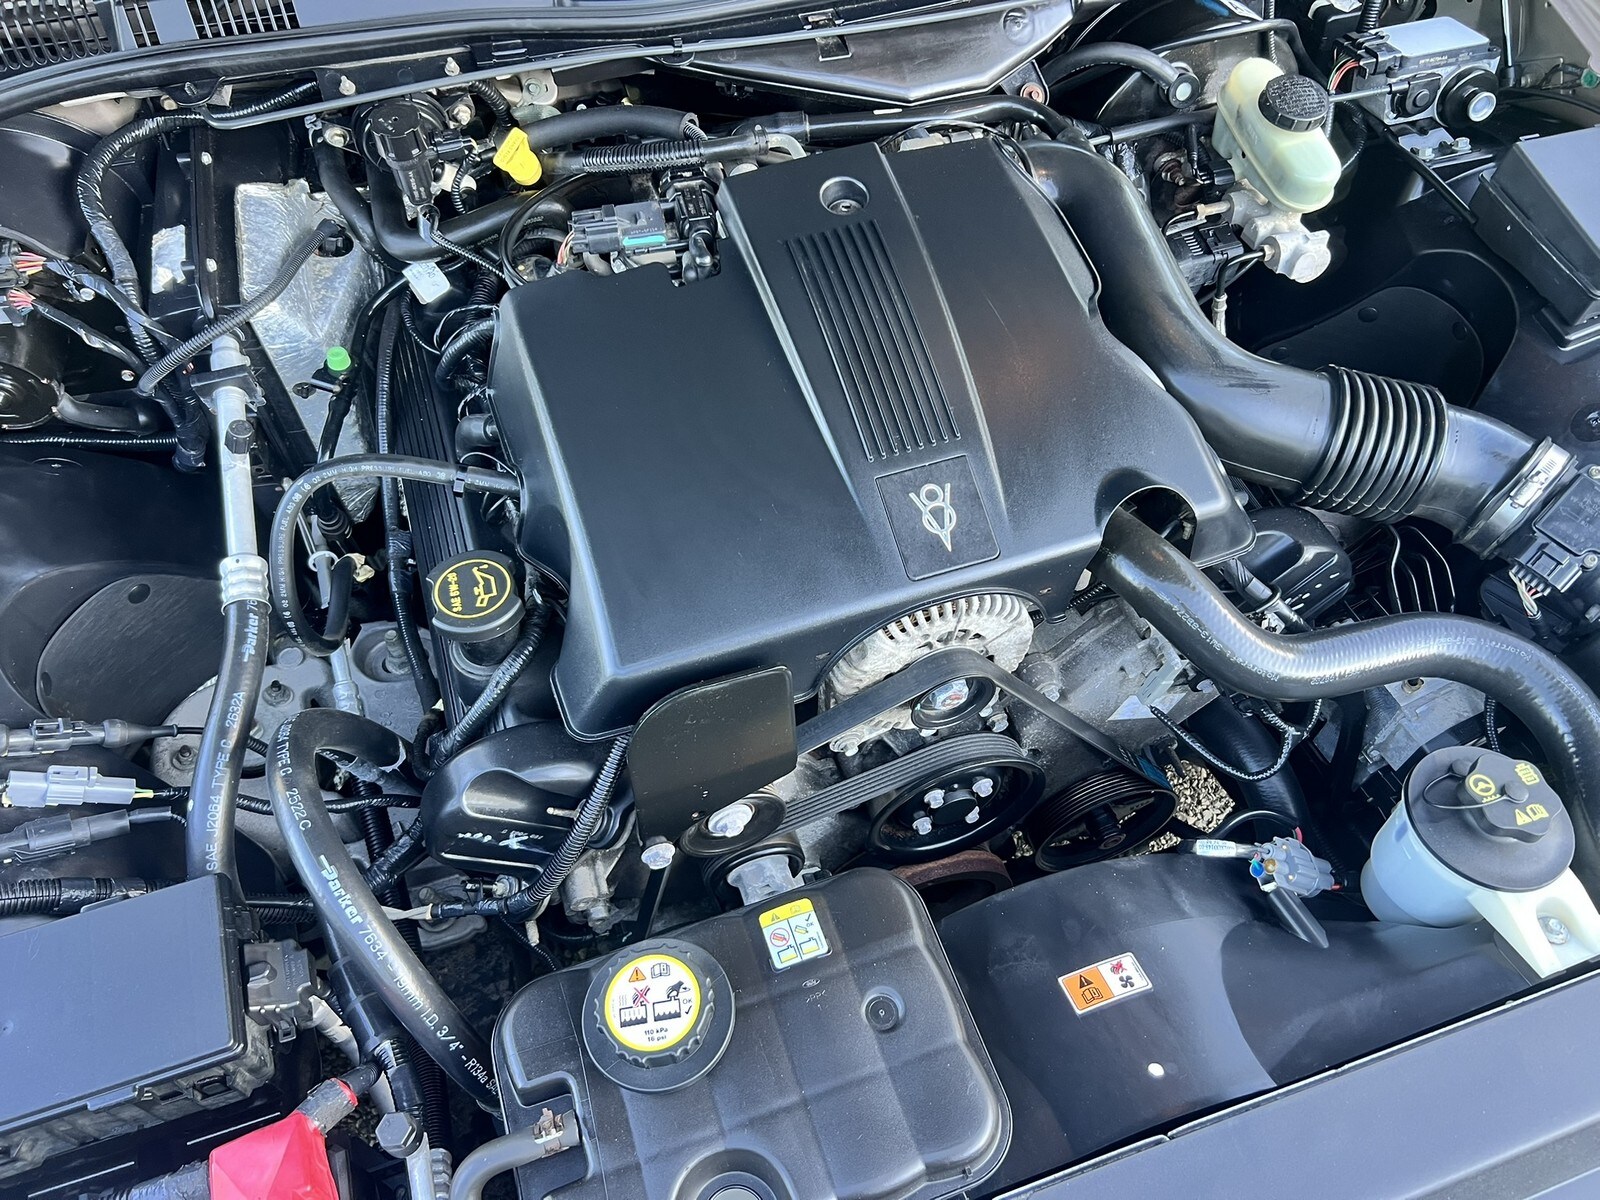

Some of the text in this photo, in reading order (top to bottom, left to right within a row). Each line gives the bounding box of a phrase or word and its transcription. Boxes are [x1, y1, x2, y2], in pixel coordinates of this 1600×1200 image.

[447, 572, 462, 613] SAE 5W-20
[241, 612, 259, 662] Parker
[1226, 651, 1280, 682] Motorcraft
[276, 741, 291, 768] TYPE
[280, 767, 293, 777] C
[205, 691, 246, 872] SAE J2064 TYPE C 2632A
[320, 855, 363, 926] Parker
[358, 924, 389, 961] 7634
[393, 974, 423, 1012] 19mm
[464, 1057, 489, 1085] R134a
[656, 1027, 669, 1035] kPa
